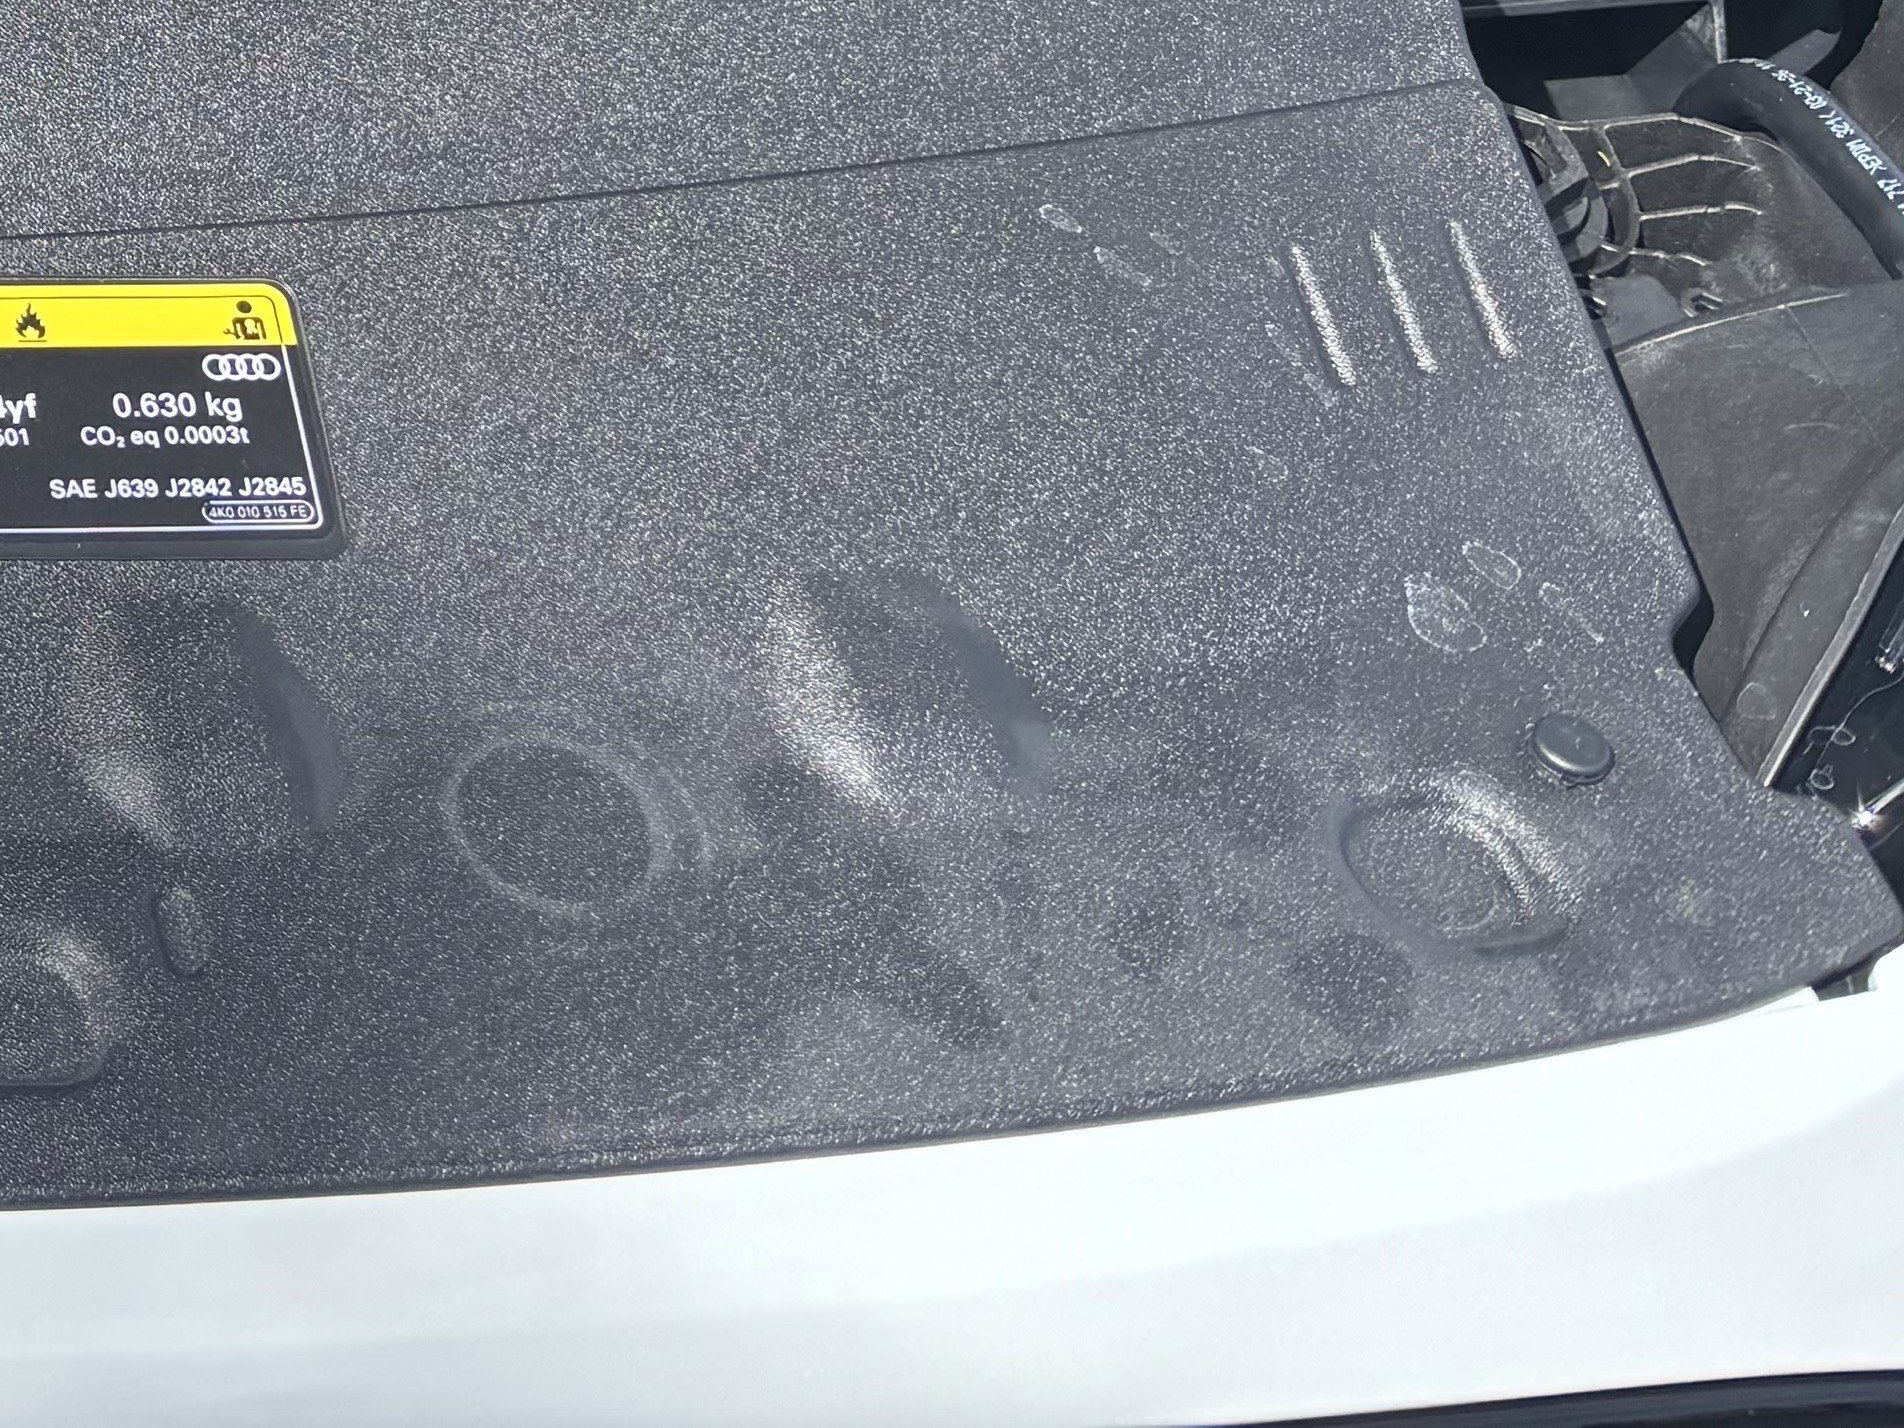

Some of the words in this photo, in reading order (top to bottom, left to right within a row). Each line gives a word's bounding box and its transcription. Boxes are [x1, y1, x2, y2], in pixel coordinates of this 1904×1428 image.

[113, 392, 196, 418] 0.630
[205, 392, 242, 422] kg
[130, 431, 160, 448] eq
[165, 425, 250, 444] 0.0003t
[50, 479, 98, 499] SAE
[105, 479, 159, 498] J639
[165, 478, 232, 497] J2842
[239, 477, 306, 496] J2845
[209, 506, 234, 518] 4K0
[238, 506, 260, 518] 010
[290, 505, 307, 517] FE
